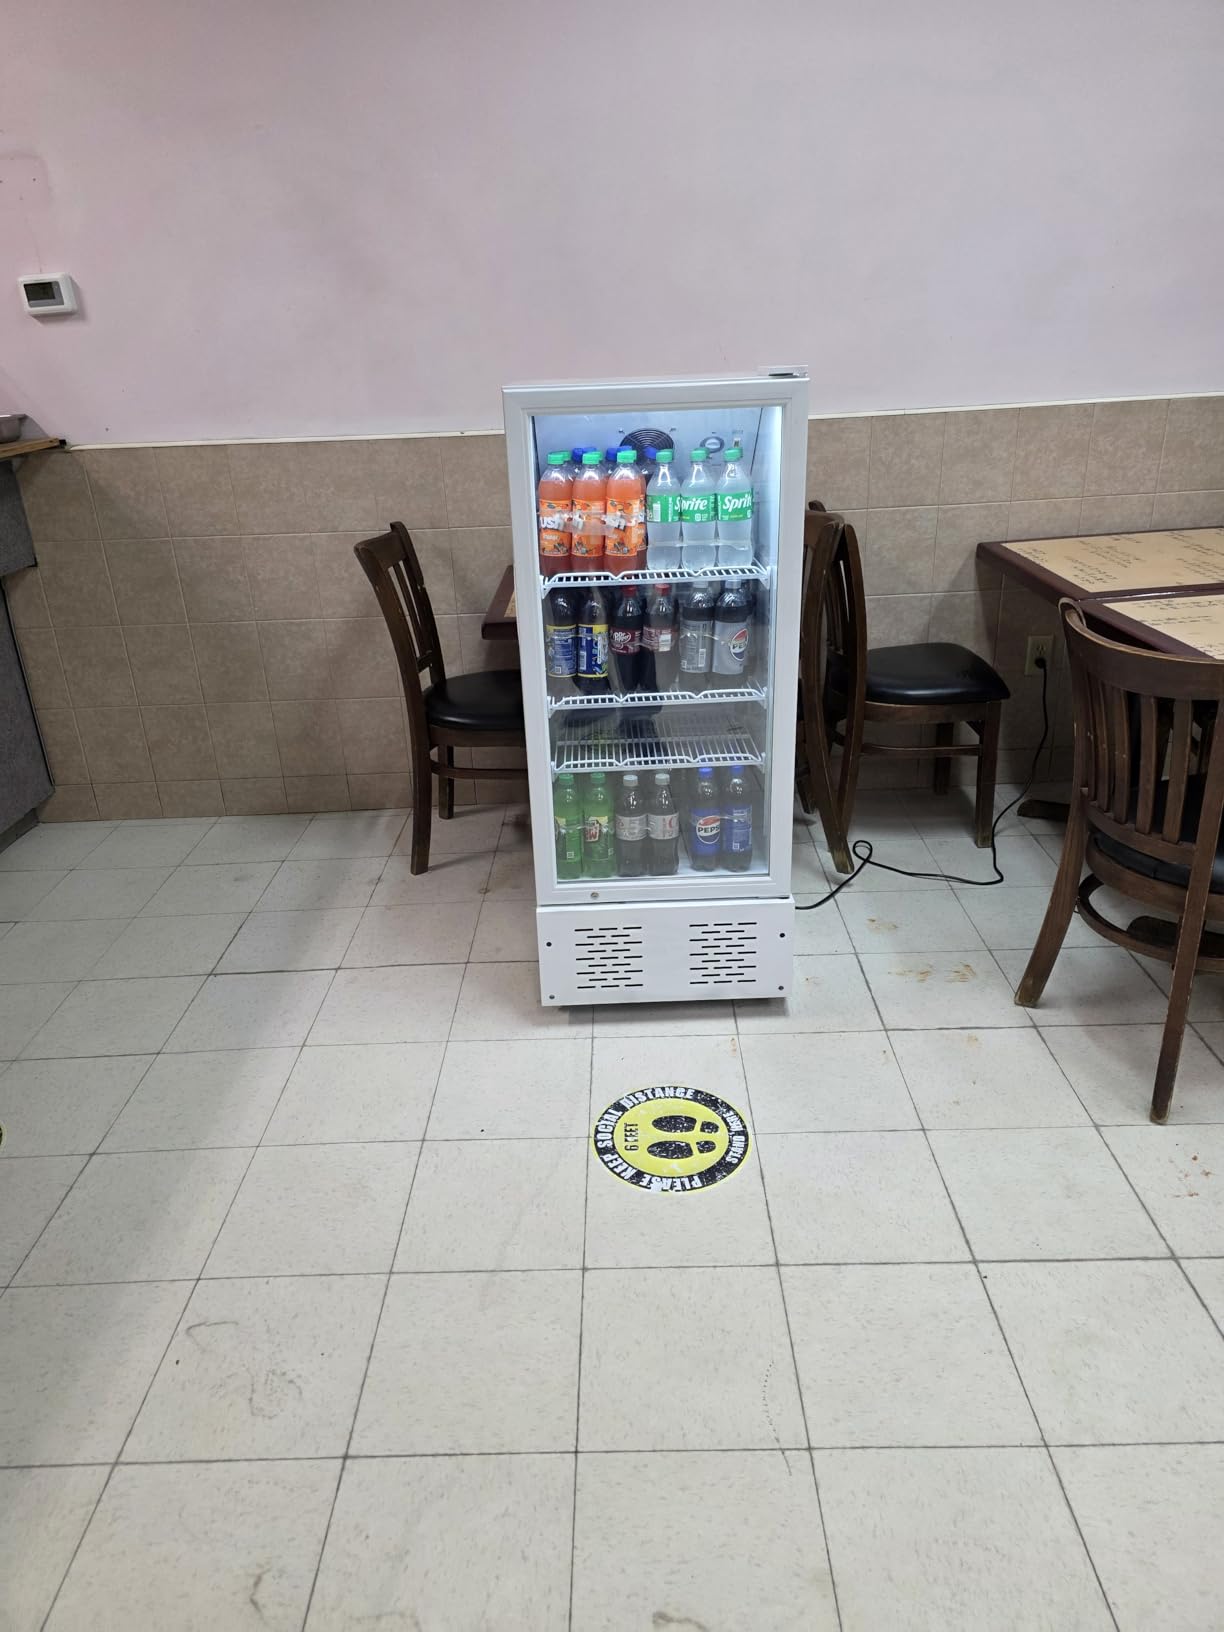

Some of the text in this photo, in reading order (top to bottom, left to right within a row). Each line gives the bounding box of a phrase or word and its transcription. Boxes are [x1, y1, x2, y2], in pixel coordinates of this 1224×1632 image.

[722, 493, 752, 513] Sprit
[697, 825, 720, 834] PEPS
[597, 1086, 704, 1193] PLEASE KEEP SOCIAL DISTANCE
[624, 1144, 640, 1152] 6
[725, 1135, 746, 1164] STAND
